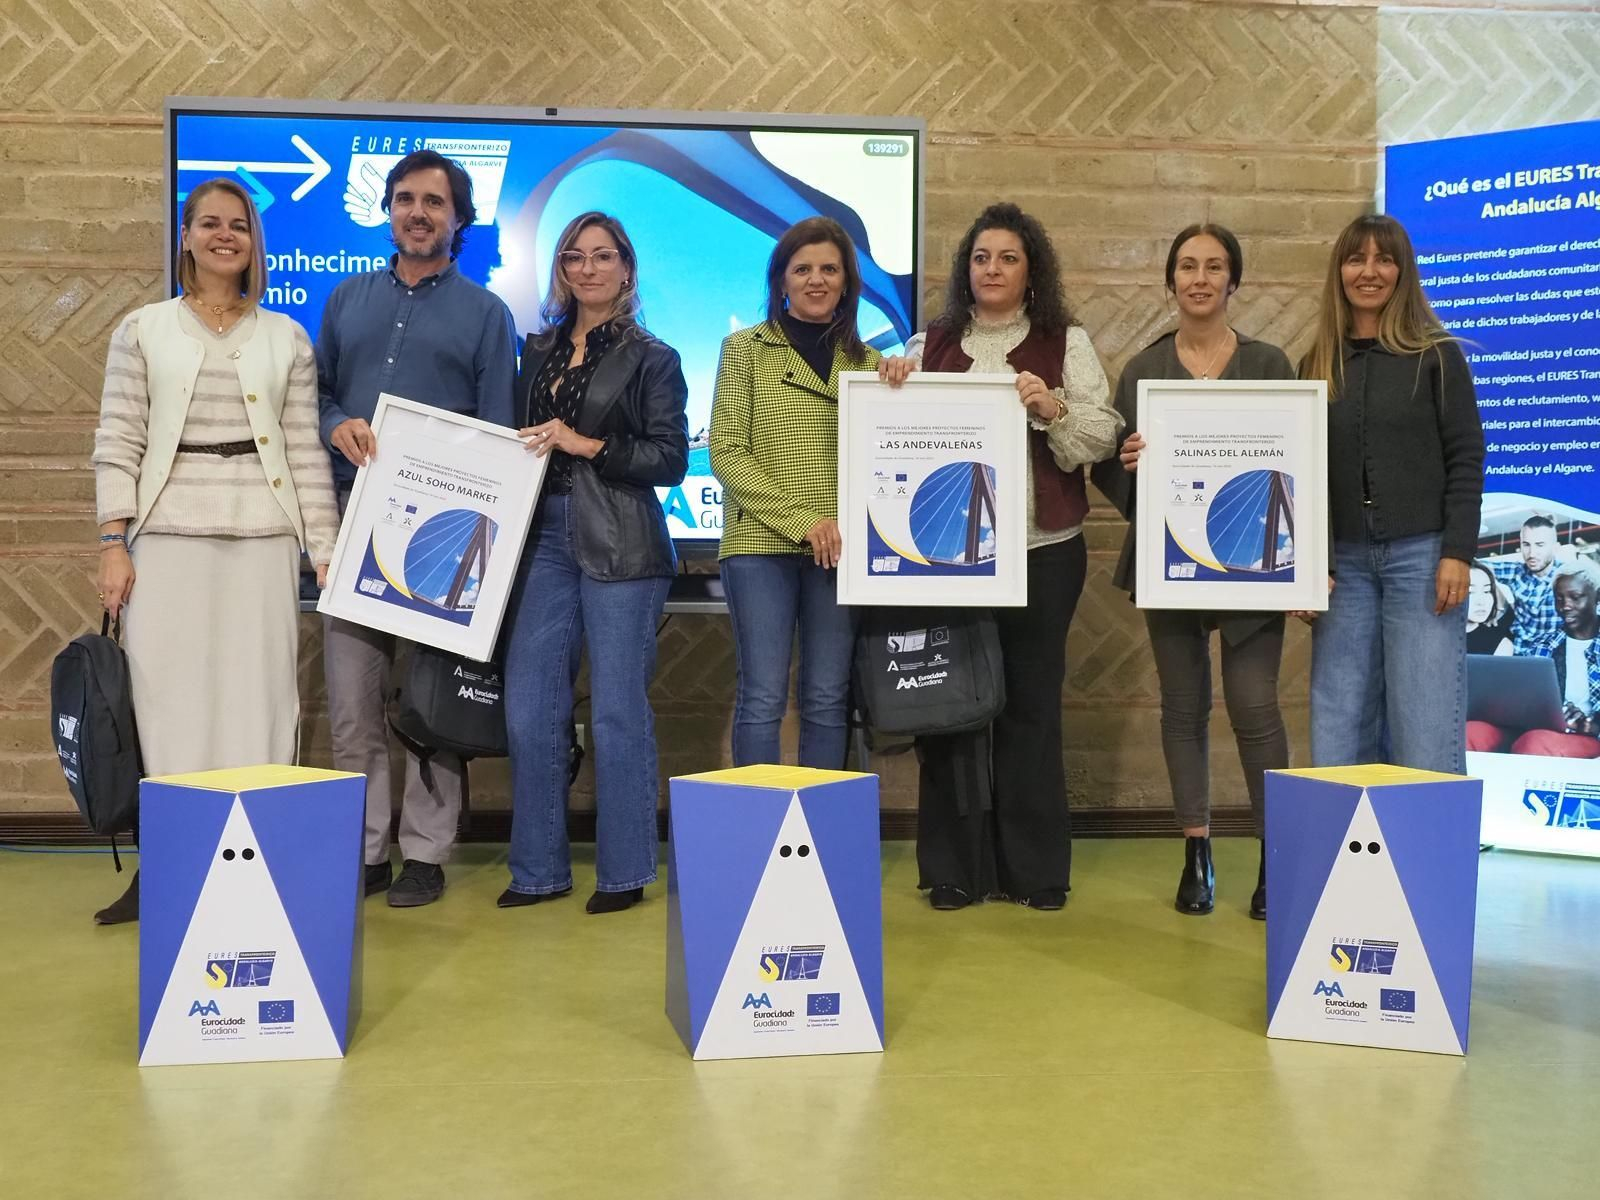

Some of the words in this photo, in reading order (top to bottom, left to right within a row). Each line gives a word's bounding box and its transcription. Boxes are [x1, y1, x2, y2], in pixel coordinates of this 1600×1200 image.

[351, 136, 421, 153] EURES
[867, 143, 904, 154] 139291
[1424, 178, 1468, 202] ¿Qué
[1471, 178, 1491, 192] es
[1494, 172, 1511, 189] el
[1515, 165, 1573, 187] EURES
[1481, 194, 1571, 219] Andalucía
[1417, 253, 1435, 265] Red
[1437, 253, 1462, 263] Eures
[1463, 248, 1507, 263] pretende
[1508, 244, 1558, 258] garantizar
[1559, 241, 1568, 251] el
[1570, 239, 1600, 251] derec
[1437, 275, 1460, 287] justa
[1462, 273, 1474, 284] de
[1475, 272, 1489, 282] los
[1491, 268, 1547, 280] ciudadanos
[1453, 298, 1475, 308] para
[1476, 294, 1514, 305] resolver
[1516, 292, 1529, 302] las
[1531, 289, 1561, 300] dudas
[1563, 289, 1583, 300] que
[1462, 318, 1475, 328] de
[1476, 317, 1508, 327] dichos
[1510, 312, 1571, 325] trabajadores
[1572, 313, 1579, 323] y
[1581, 309, 1594, 320] de
[1471, 353, 1480, 362] la
[1482, 350, 1529, 362] movilidad
[1529, 350, 1554, 361] justa
[1555, 351, 1562, 360] y
[1563, 347, 1572, 357] el
[1492, 374, 1535, 386] regiones,
[1536, 372, 1546, 382] el
[1547, 370, 1579, 381] EURES
[1503, 396, 1516, 406] de
[1518, 394, 1590, 406] reclutamiento,
[1509, 421, 1530, 431] para
[1532, 418, 1541, 428] el
[880, 440, 900, 449] LAS
[902, 439, 983, 449] ANDEVALEÑAS
[1487, 443, 1499, 452] de
[1501, 442, 1540, 454] negocio
[1542, 443, 1549, 453] y
[1550, 440, 1588, 452] empleo
[1174, 449, 1217, 457] SALINAS
[1219, 449, 1238, 457] DEL
[1240, 447, 1284, 457] ALEMÁN
[1485, 464, 1533, 475] Andalucía
[1535, 466, 1541, 476] y
[1543, 464, 1552, 474] el
[1554, 463, 1595, 476] Algarve.
[397, 469, 424, 483] AZUL
[426, 477, 456, 492] SOHO
[456, 486, 499, 504] MARKET
[1332, 937, 1362, 945] EURES
[761, 945, 790, 953] EURES
[1325, 1007, 1360, 1017] Guadiana
[753, 1019, 787, 1028] Guadiana
[201, 1027, 238, 1036] Guadiana
